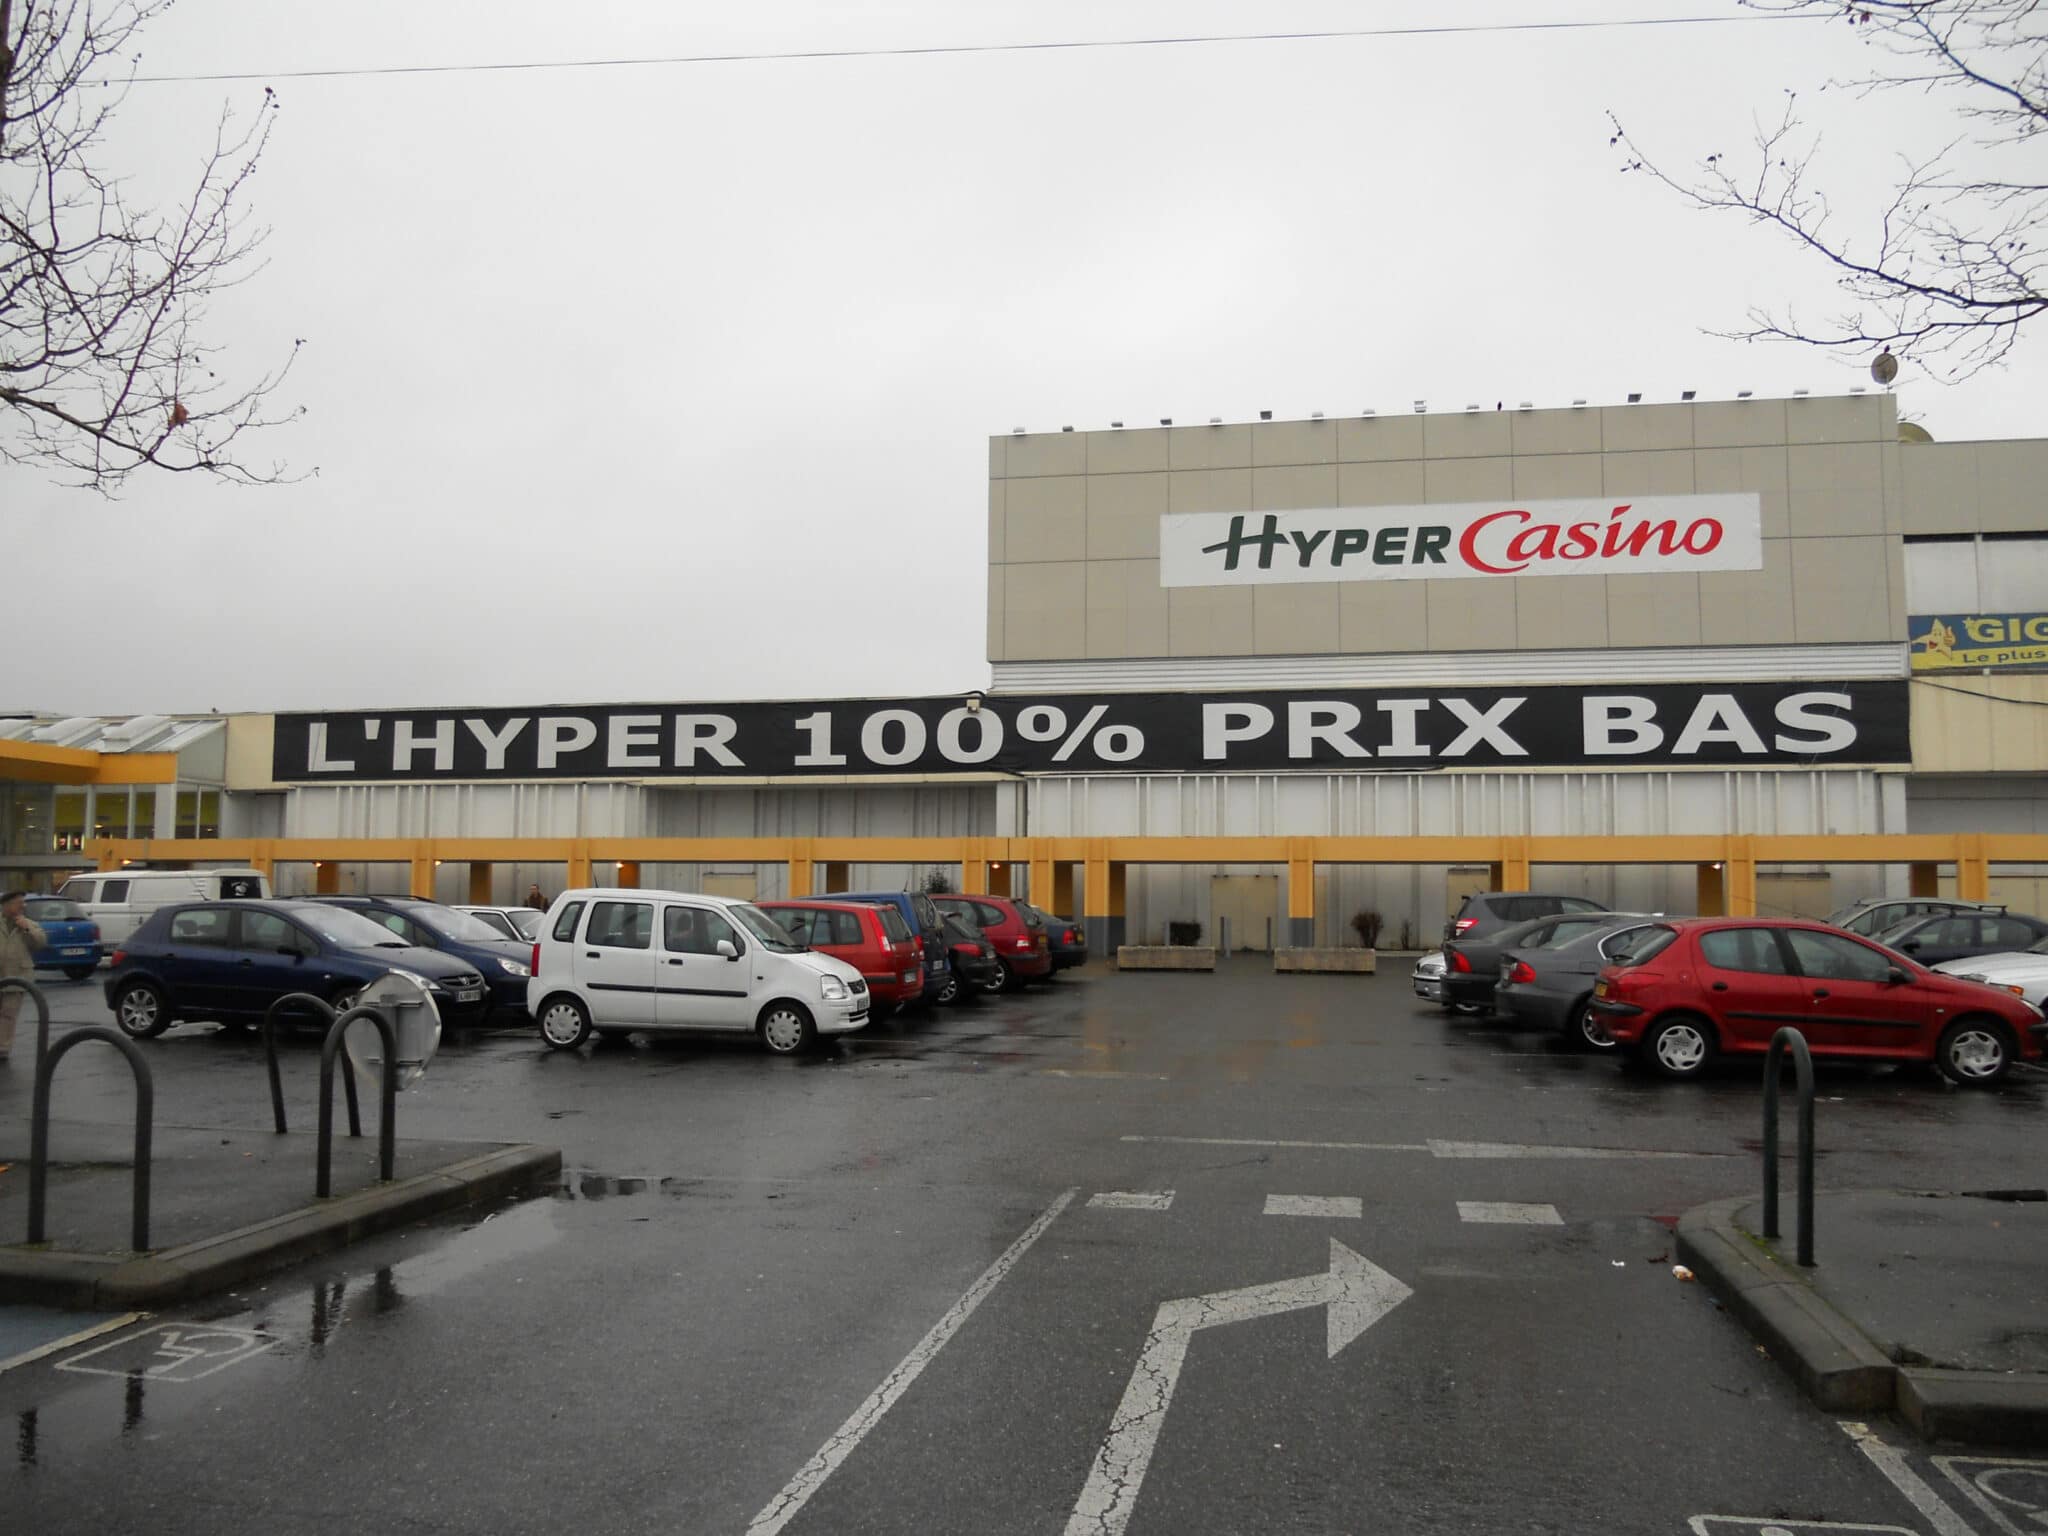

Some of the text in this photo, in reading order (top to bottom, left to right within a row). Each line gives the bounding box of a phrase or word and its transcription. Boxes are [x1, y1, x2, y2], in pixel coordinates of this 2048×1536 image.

[1458, 505, 1724, 574] Casino
[1963, 650, 2046, 663] Le plus
[307, 692, 1857, 772] L'HYPER 100% PRIX BAS
